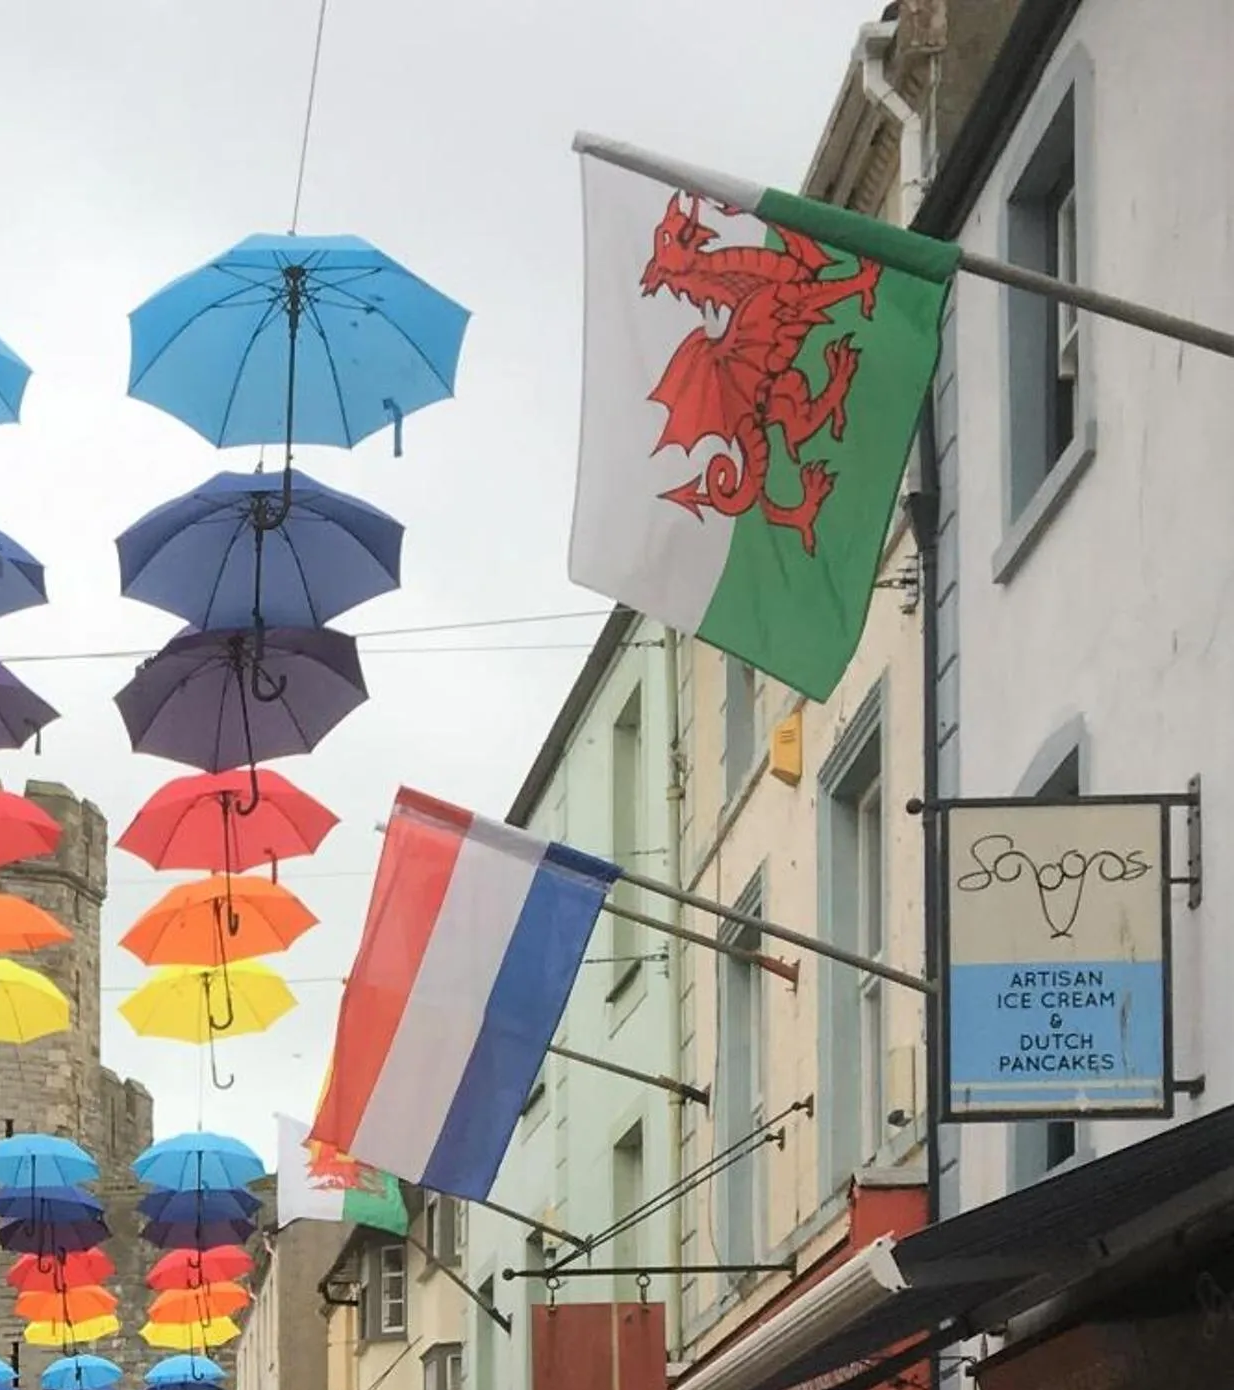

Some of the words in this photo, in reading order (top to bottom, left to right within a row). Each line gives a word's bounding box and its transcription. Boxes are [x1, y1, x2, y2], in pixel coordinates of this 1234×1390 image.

[1010, 970, 1103, 988] ARTISAN
[998, 994, 1031, 1009] ICE
[1041, 992, 1115, 1008] CREAM
[1050, 1013, 1063, 1029] &
[1020, 1033, 1094, 1050] DUTCH
[998, 1054, 1115, 1073] PANCAKES
